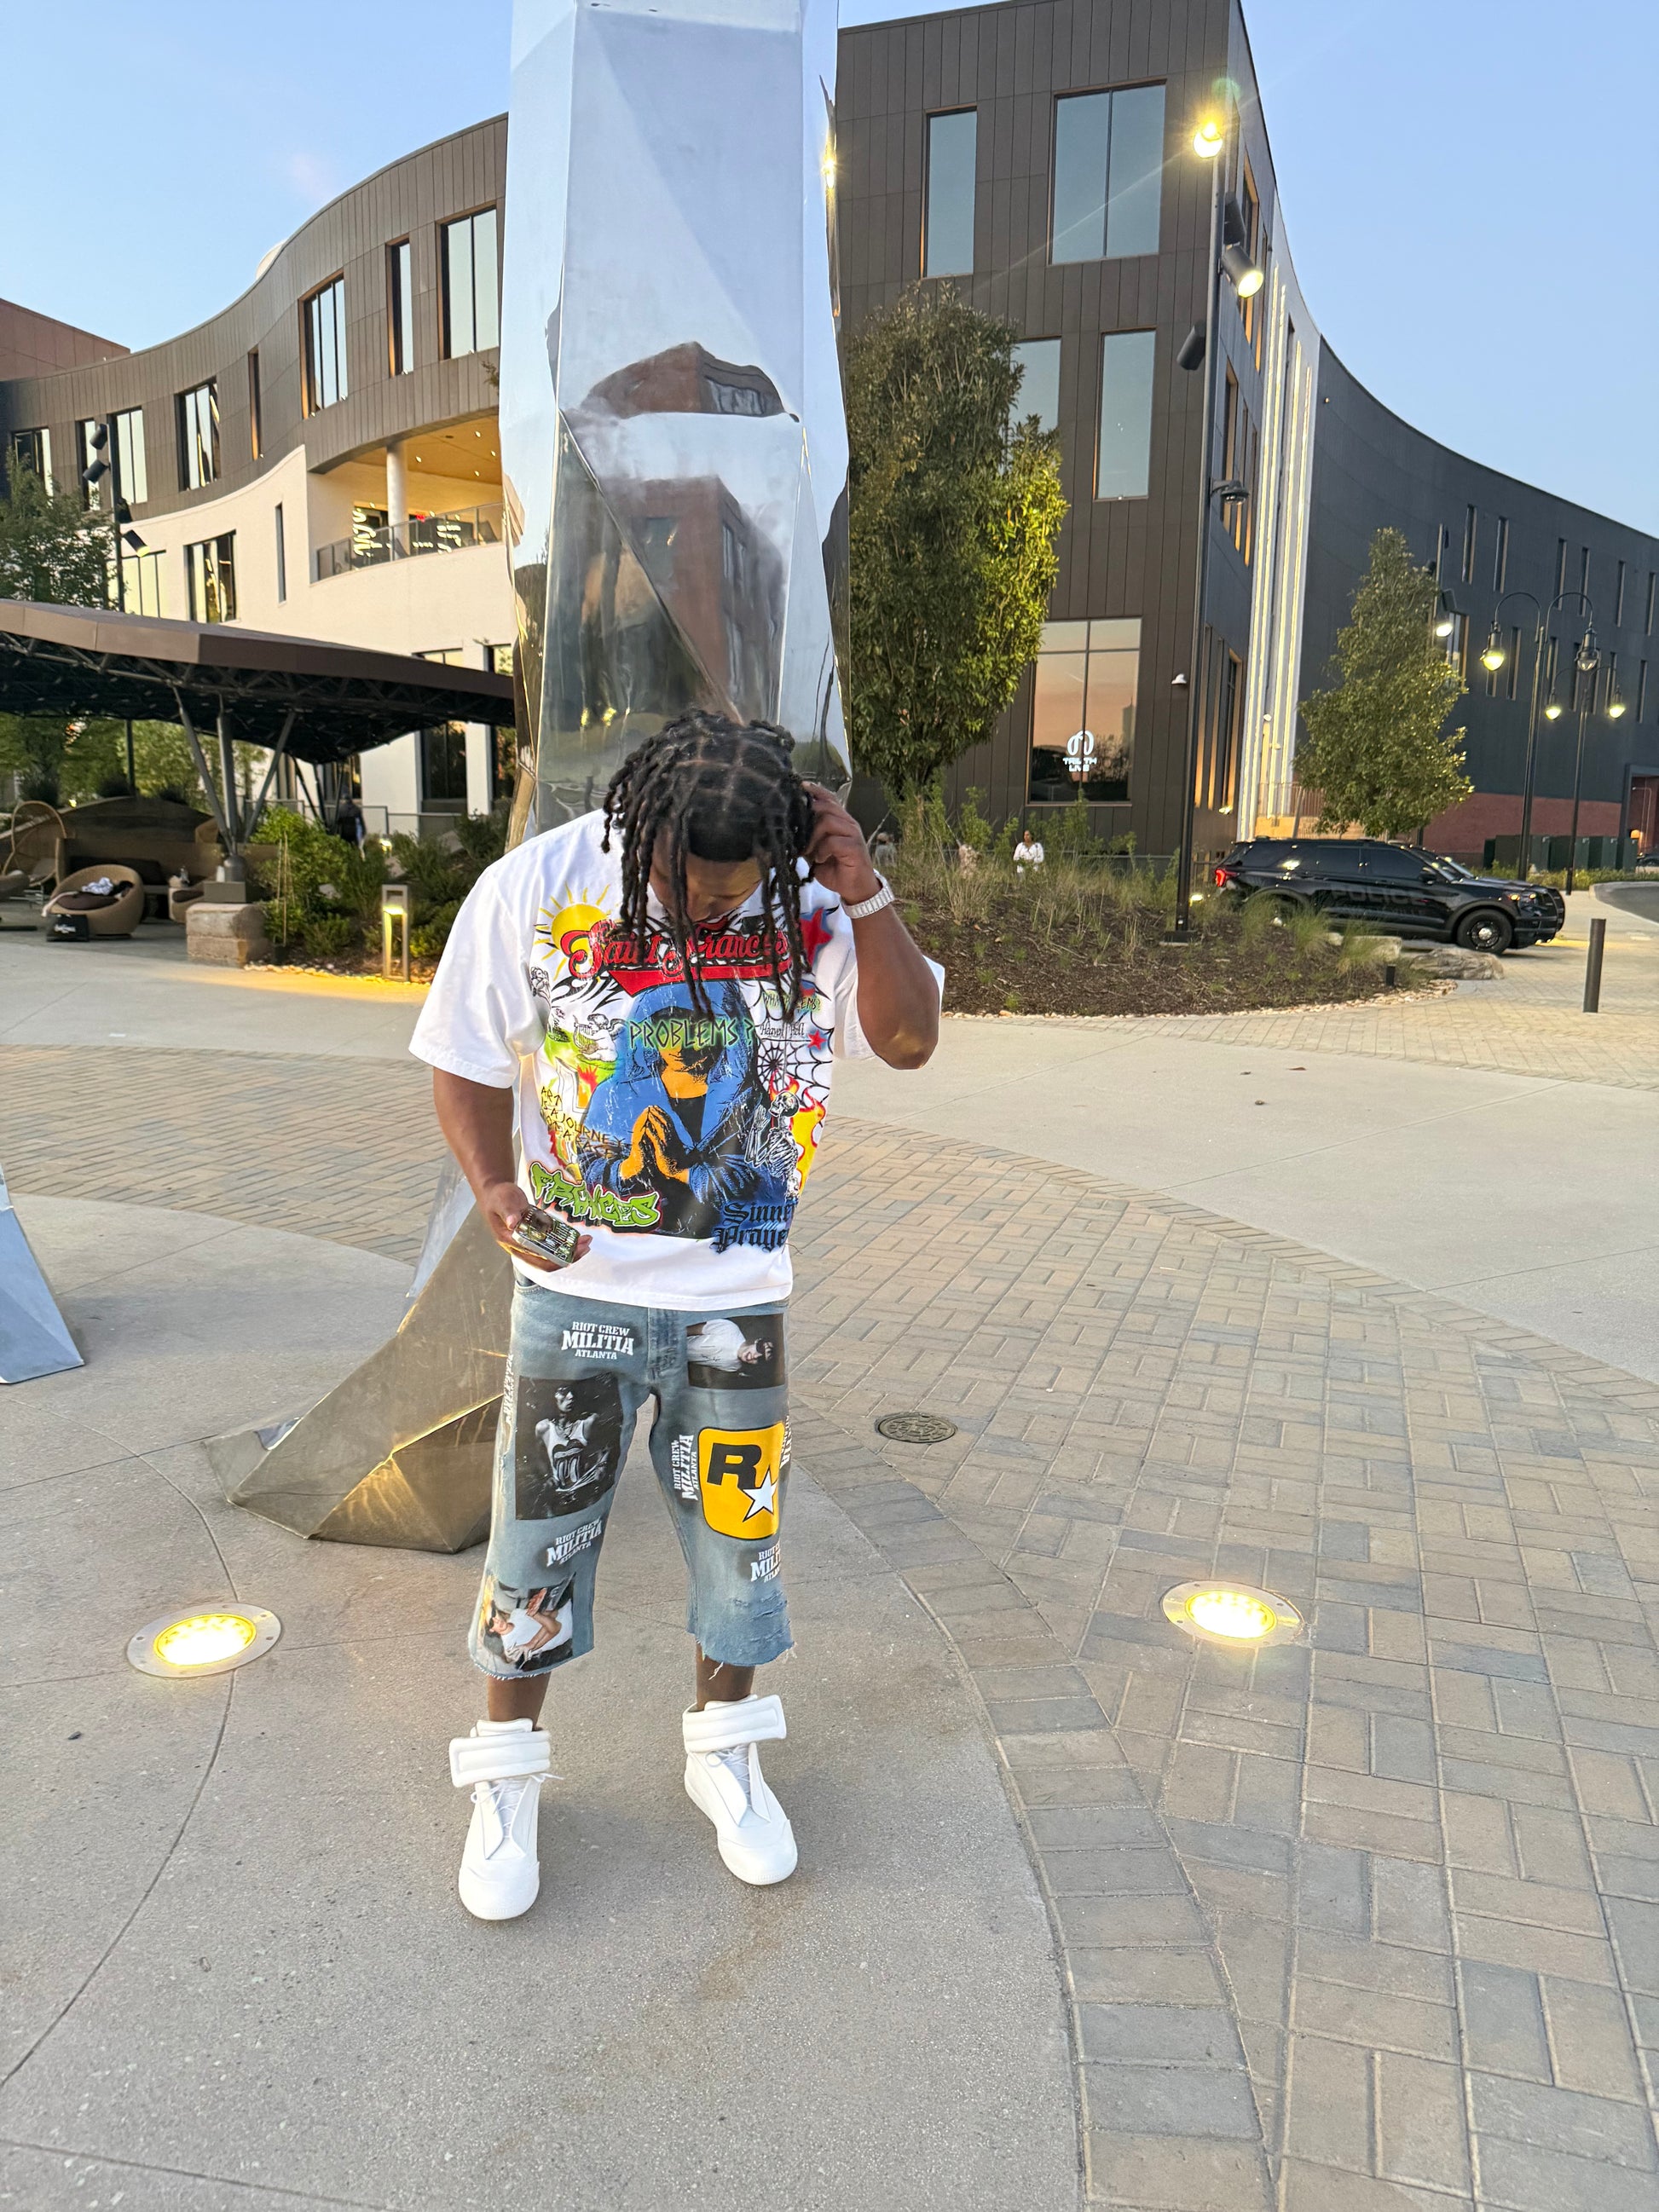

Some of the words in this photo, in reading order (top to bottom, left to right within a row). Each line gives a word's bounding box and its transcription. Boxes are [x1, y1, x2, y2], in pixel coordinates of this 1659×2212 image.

[1331, 885, 1425, 906] POLICE
[558, 1112, 627, 1149] JOURNEY
[561, 1330, 634, 1356] MILITIA
[572, 1321, 598, 1333] RIOT
[598, 1325, 631, 1337] CREW
[575, 1349, 617, 1360] ATLANTA
[671, 1440, 680, 1468] CREW
[679, 1435, 699, 1501] MILITIA
[707, 1442, 762, 1491] R
[673, 1467, 682, 1491] RIOT
[691, 1452, 700, 1491] ATLANTA
[546, 1520, 603, 1567] MILITIA
[555, 1530, 577, 1546] RIOT
[577, 1516, 601, 1534] CREW
[559, 1541, 592, 1565] ATLANTA
